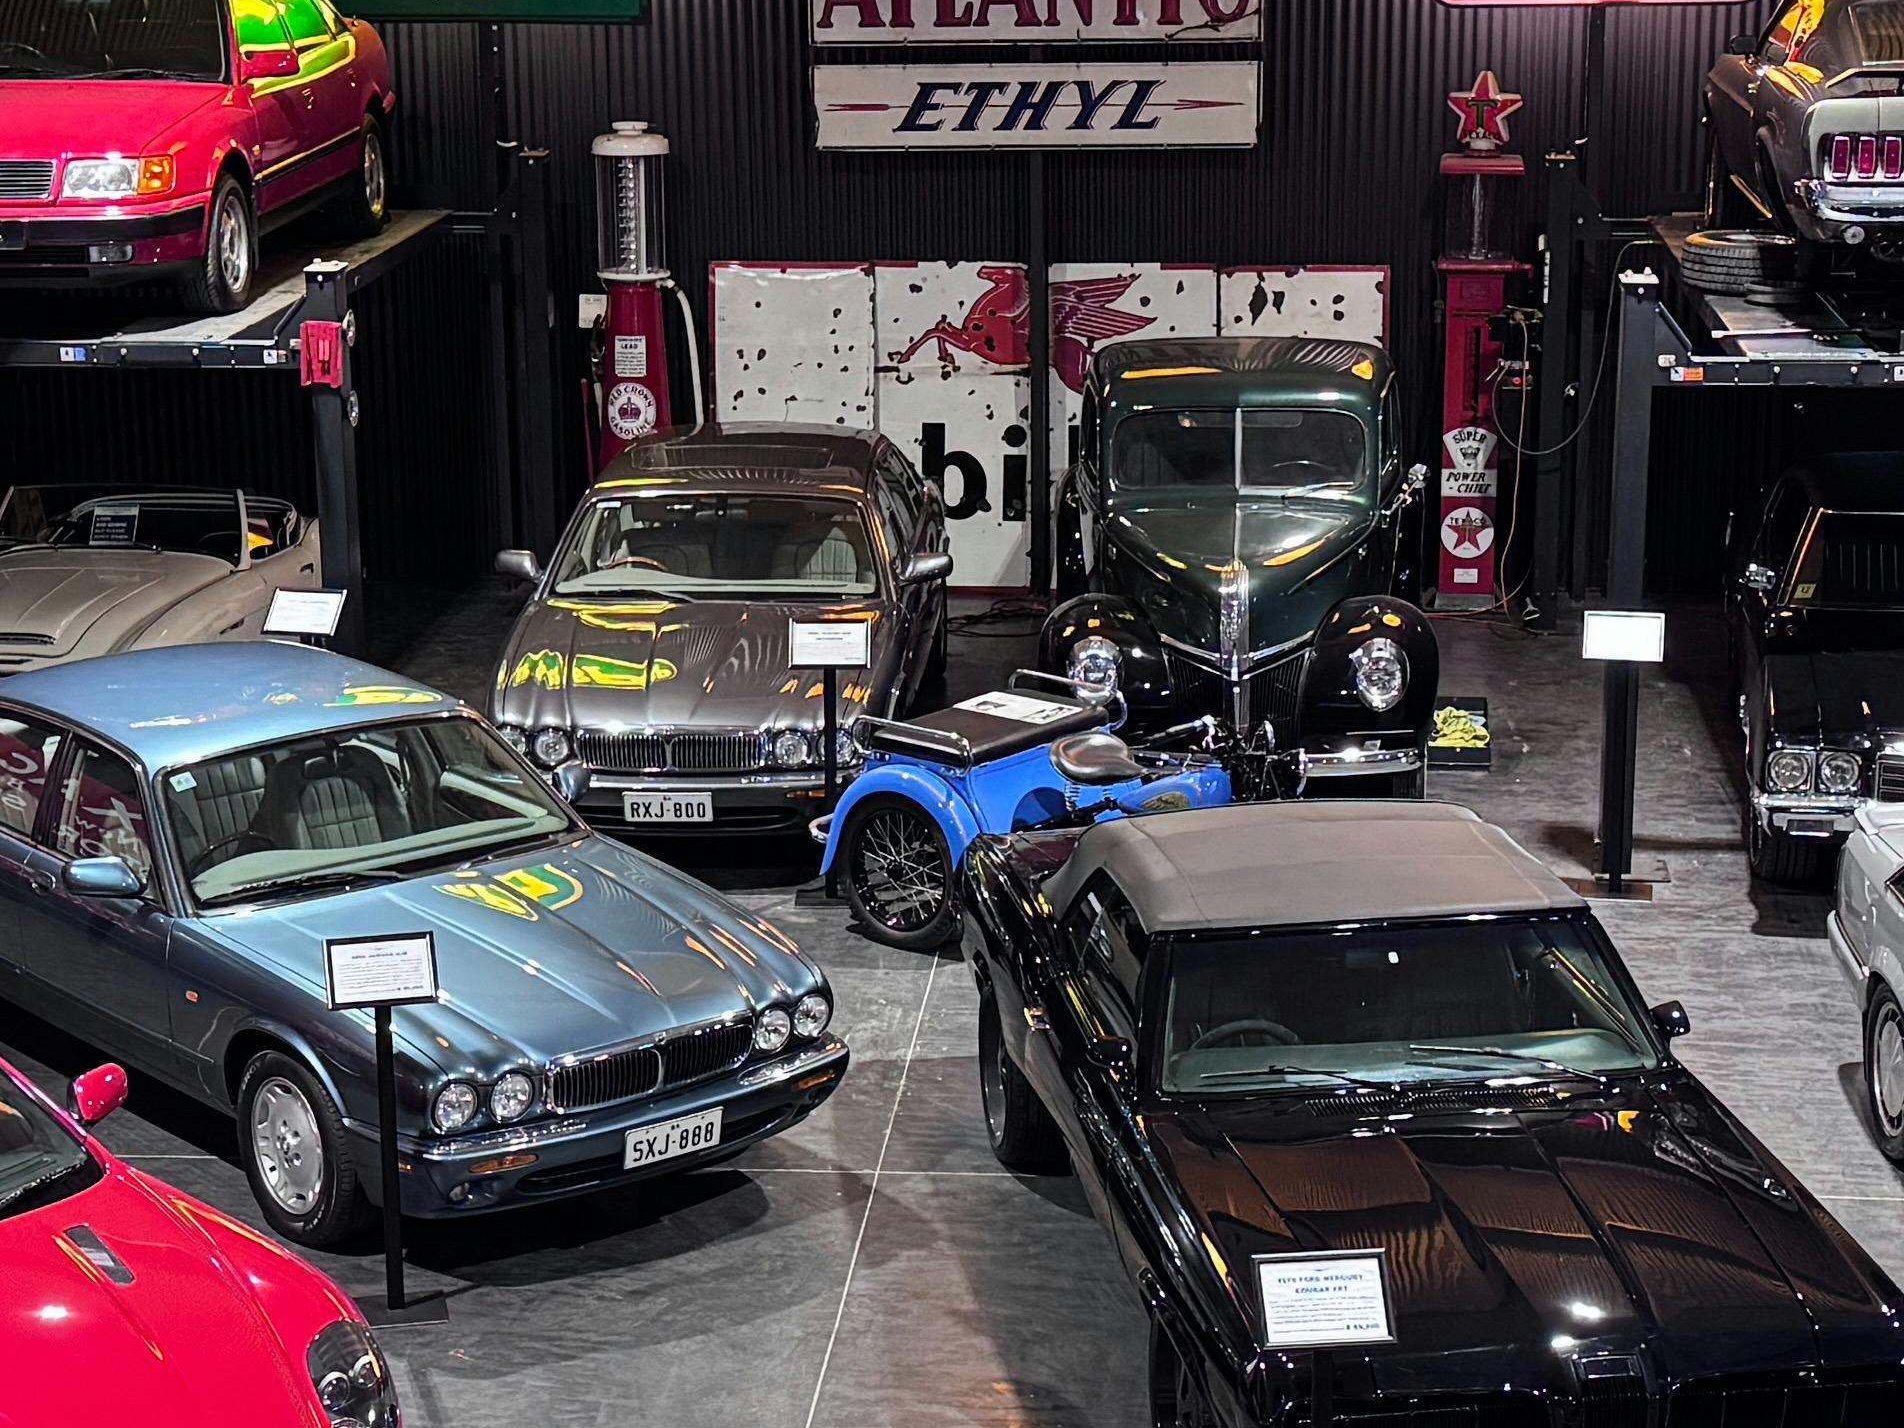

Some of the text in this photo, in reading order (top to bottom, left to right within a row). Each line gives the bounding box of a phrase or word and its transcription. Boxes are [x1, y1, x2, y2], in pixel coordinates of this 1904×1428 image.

[891, 78, 1169, 134] ETHYL
[1451, 430, 1488, 446] SUPER
[1446, 471, 1487, 484] POWER
[630, 801, 707, 820] RXJ-800
[632, 1120, 715, 1163] SXJ-888
